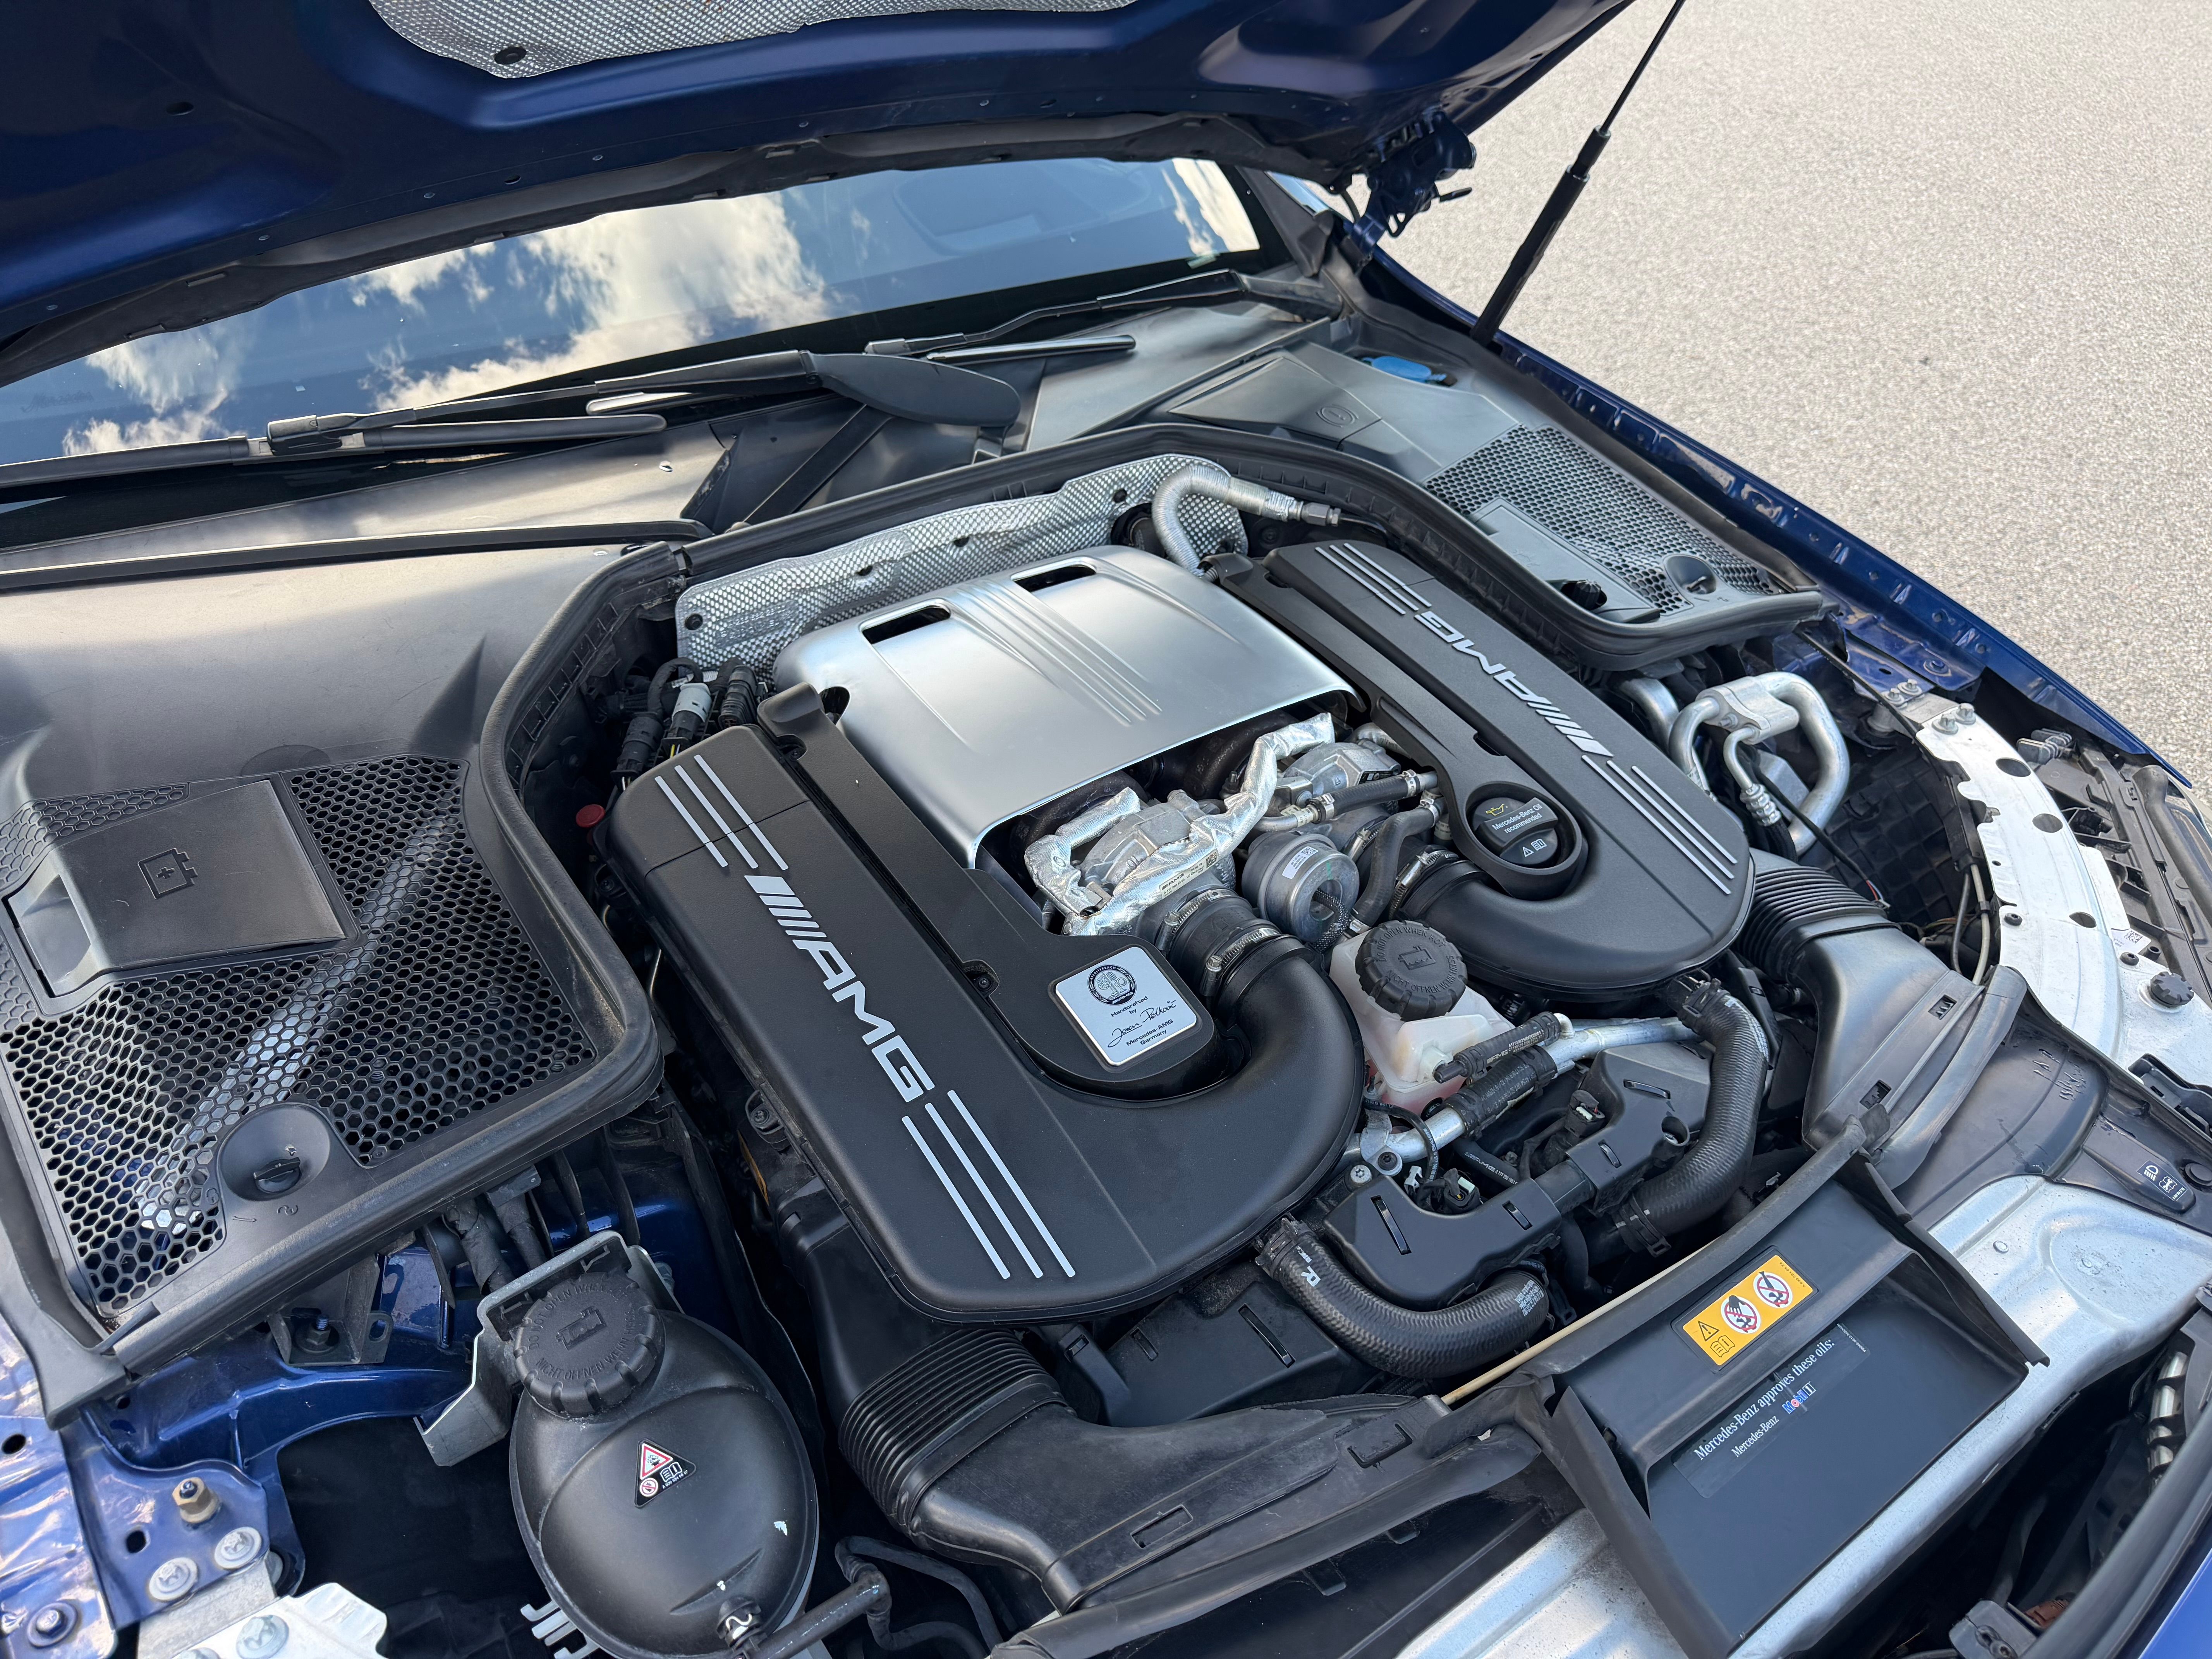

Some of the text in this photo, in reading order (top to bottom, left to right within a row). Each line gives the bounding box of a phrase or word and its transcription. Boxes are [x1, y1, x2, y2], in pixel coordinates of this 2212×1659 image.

[1414, 611, 1552, 704] AMG
[1492, 808, 1535, 830] Mercedes-Benz
[1504, 812, 1542, 833] recommended
[1377, 952, 1387, 962] DO
[1403, 927, 1427, 937] WHEN
[1429, 935, 1446, 948] HOT
[1111, 996, 1148, 1017] Handcrafted
[792, 939, 935, 1102] AMG
[1126, 1019, 1173, 1046] Mercedes-AMG
[1140, 1030, 1167, 1045] Germany
[1301, 1265, 1321, 1287] R
[1693, 1339, 1835, 1460] Mercedes-Benz approves these oils:
[1782, 1389, 1809, 1414] Mobil
[1731, 1415, 1779, 1457] Mercedes-Benz
